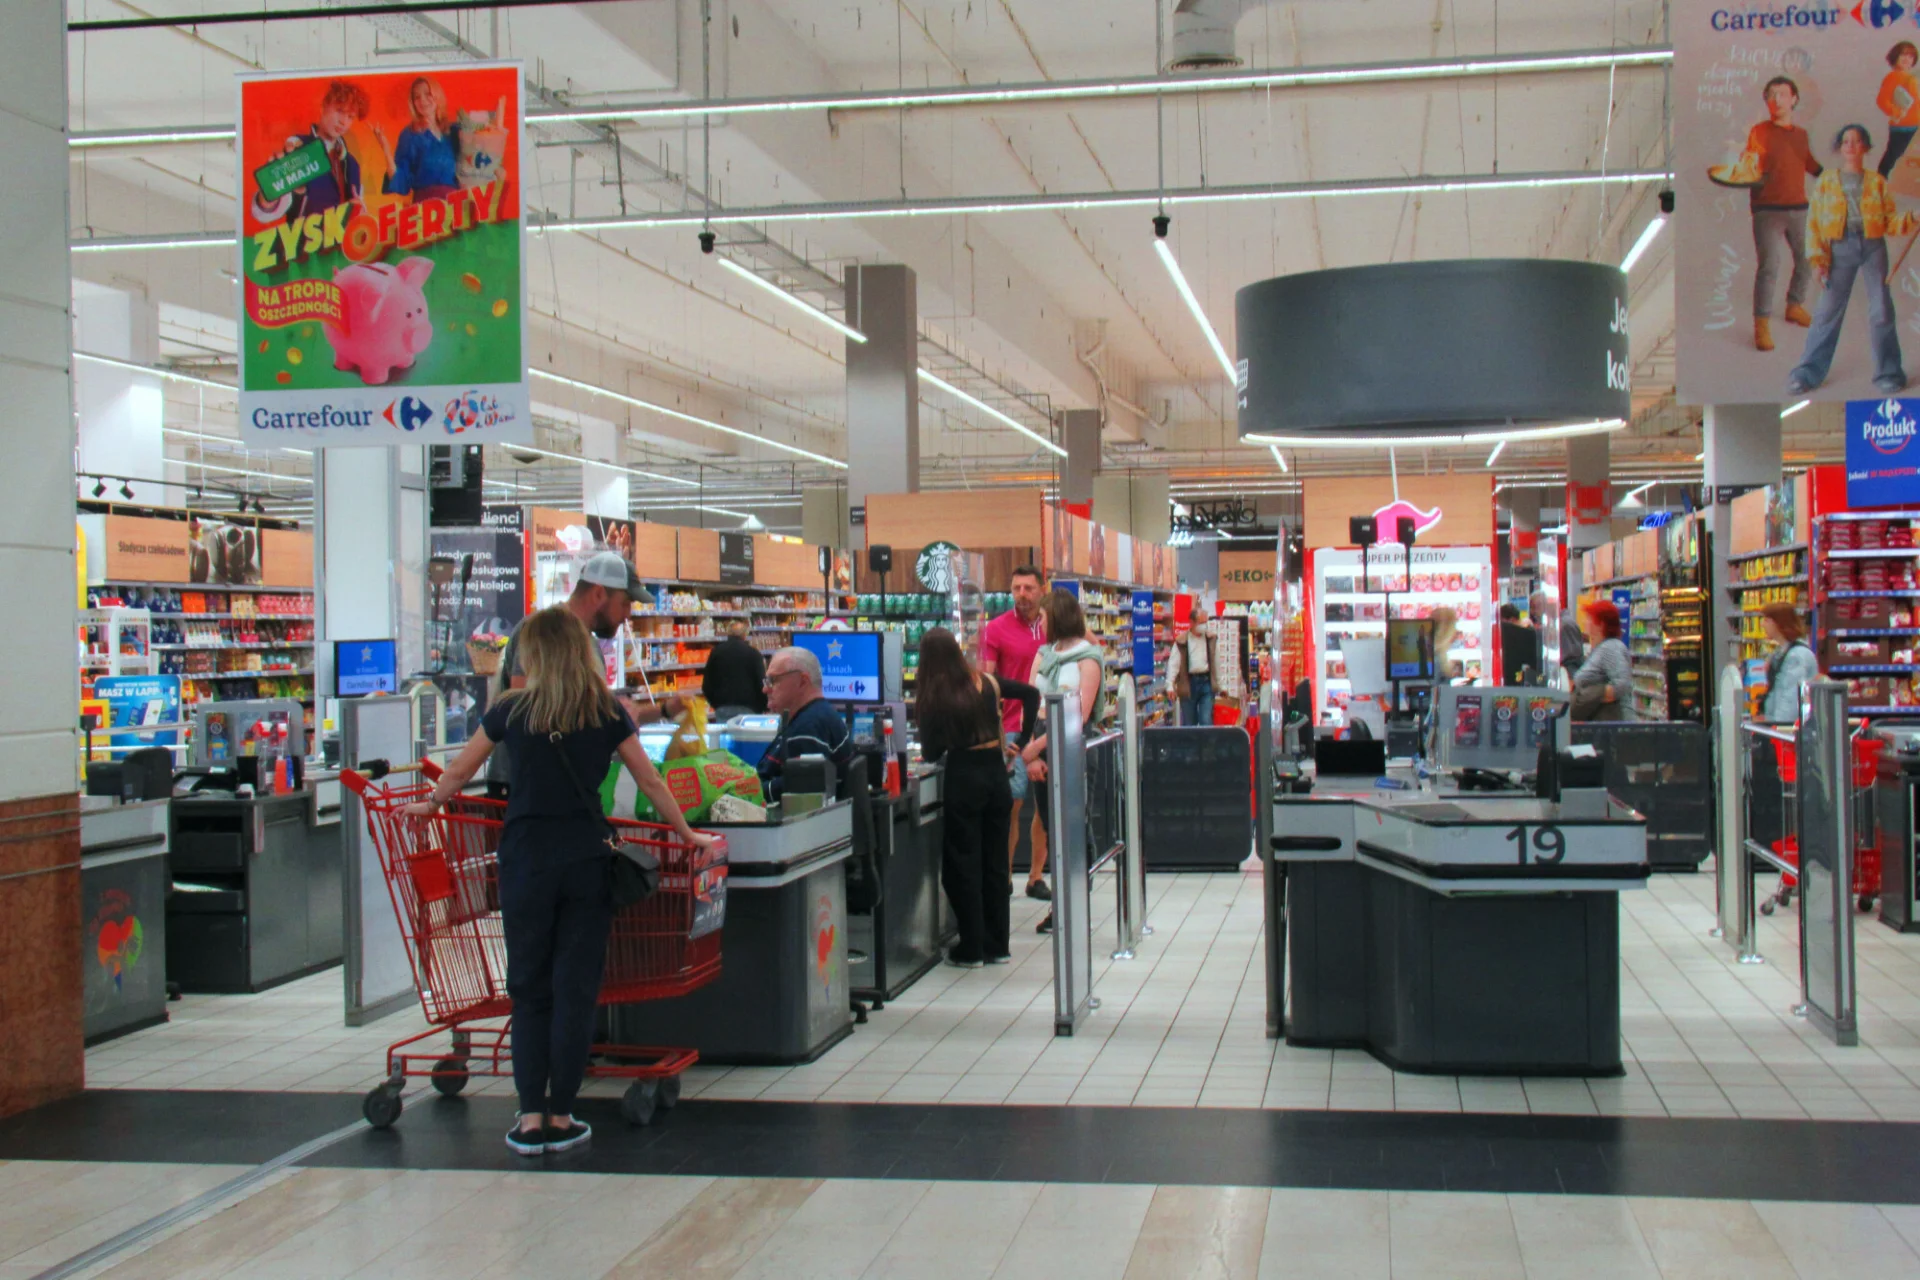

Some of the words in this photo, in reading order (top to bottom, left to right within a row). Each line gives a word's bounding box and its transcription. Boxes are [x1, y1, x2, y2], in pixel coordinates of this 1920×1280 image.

[1711, 6, 1840, 31] Carrefour
[272, 179, 285, 192] W
[285, 160, 320, 185] MAJU
[258, 288, 281, 306] NA
[284, 281, 341, 305] TROPIE
[252, 405, 373, 429] Carrefour
[1863, 416, 1917, 440] Produkt
[482, 511, 520, 524] lienci
[1234, 569, 1263, 583] EKO
[1505, 825, 1566, 865] 19
